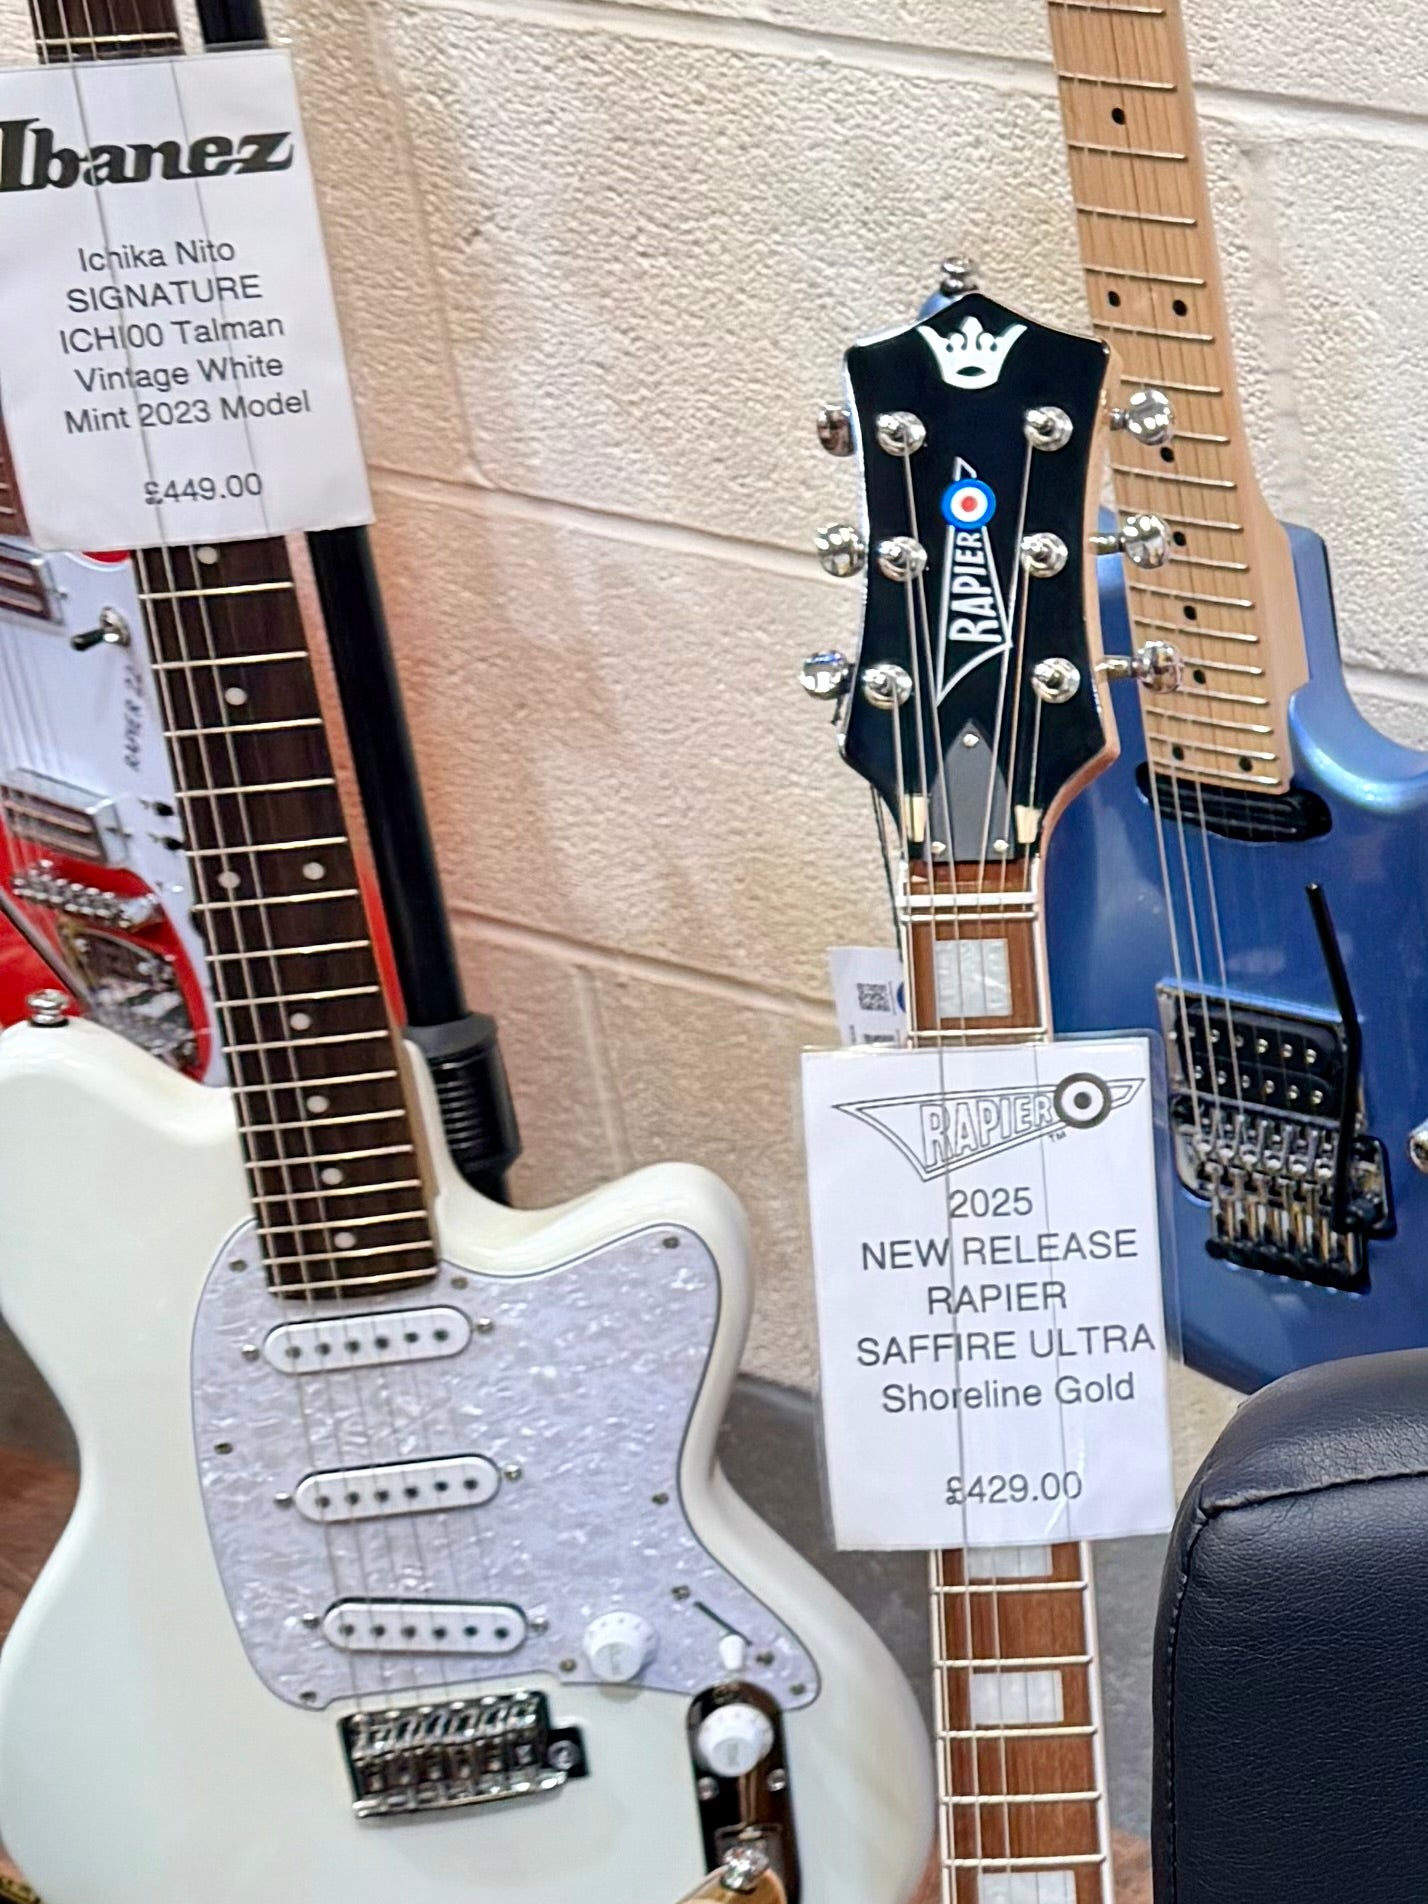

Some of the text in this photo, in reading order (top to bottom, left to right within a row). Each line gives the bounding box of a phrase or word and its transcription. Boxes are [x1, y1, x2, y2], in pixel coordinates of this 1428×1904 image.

[0, 117, 294, 193] Ibanez
[79, 240, 235, 272] Ichika Nito
[66, 274, 263, 314] SIGNATURE
[172, 317, 285, 344] Talman
[75, 355, 283, 393] Vintage White
[64, 390, 311, 434] Mint 2023 Model
[145, 472, 263, 506] £449.00
[949, 531, 1002, 642] RAPIER
[920, 1093, 1053, 1168] RAPIER
[947, 1188, 1033, 1219] 2025
[862, 1228, 1138, 1271] NEW RELEASE
[928, 1280, 1067, 1316] RAPIER
[856, 1323, 1156, 1367] SAFFIRE ULTRA
[881, 1372, 1136, 1414] Shoreline Gold
[946, 1470, 1082, 1506] £429.00
